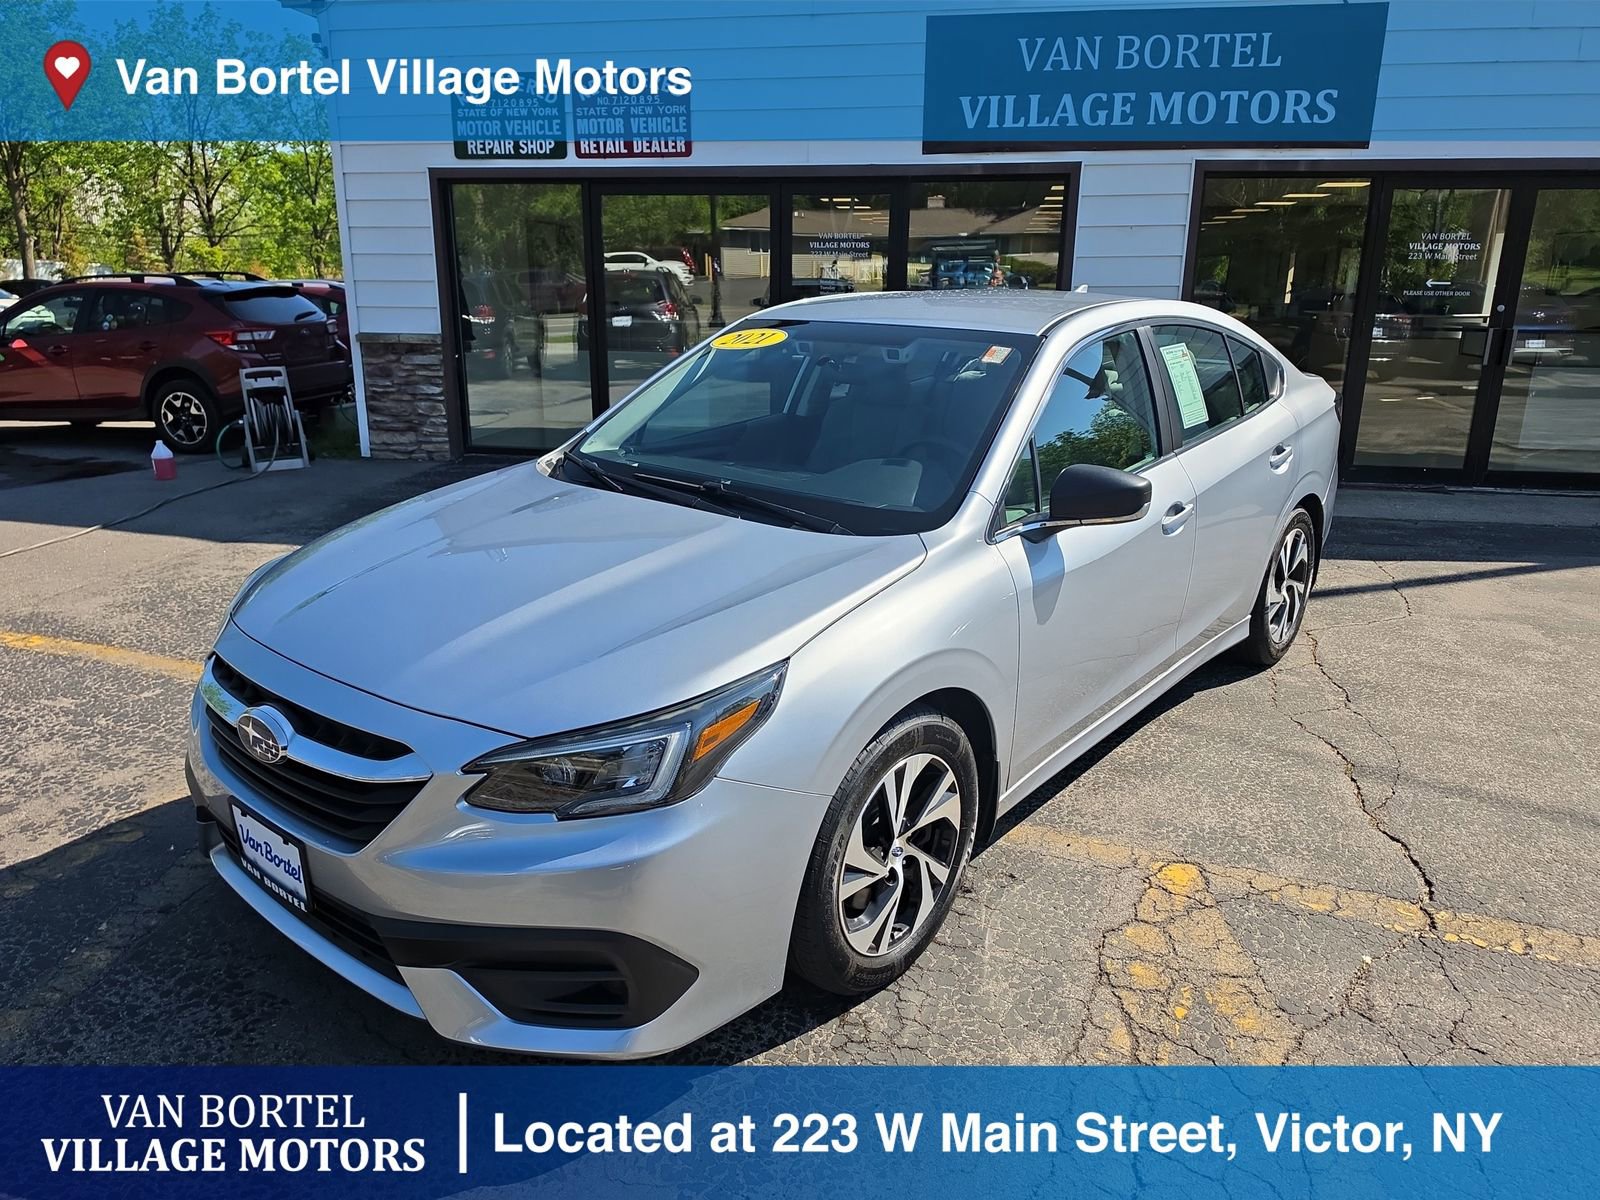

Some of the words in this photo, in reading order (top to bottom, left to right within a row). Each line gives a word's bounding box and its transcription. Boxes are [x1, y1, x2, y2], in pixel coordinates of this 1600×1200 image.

[1017, 36, 1102, 72] VAN
[1115, 32, 1282, 70] BORTEL
[457, 108, 487, 117] STATE
[490, 108, 503, 117] OF
[506, 108, 528, 117] NEW
[531, 107, 559, 117] YORK
[576, 106, 608, 116] STATE
[612, 106, 627, 115] OF
[630, 105, 653, 115] NEW
[657, 105, 687, 114] YORK
[959, 92, 1136, 129] VILLAGE
[1147, 89, 1338, 125] MOTORS
[457, 121, 501, 137] MOTOR
[505, 120, 562, 136] VEHICLE
[576, 118, 625, 135] MOTOR
[630, 116, 687, 134] VEHICLE
[467, 140, 514, 155] REPAIR
[519, 140, 555, 154] SHOP
[580, 138, 628, 154] RETAIL
[633, 136, 686, 153] DEALER
[809, 241, 839, 249] VILLAGE
[840, 241, 870, 249] MOTORS
[1408, 252, 1422, 260] 223
[1424, 252, 1433, 260] W
[1455, 252, 1478, 260] Street
[241, 857, 261, 880] VAN
